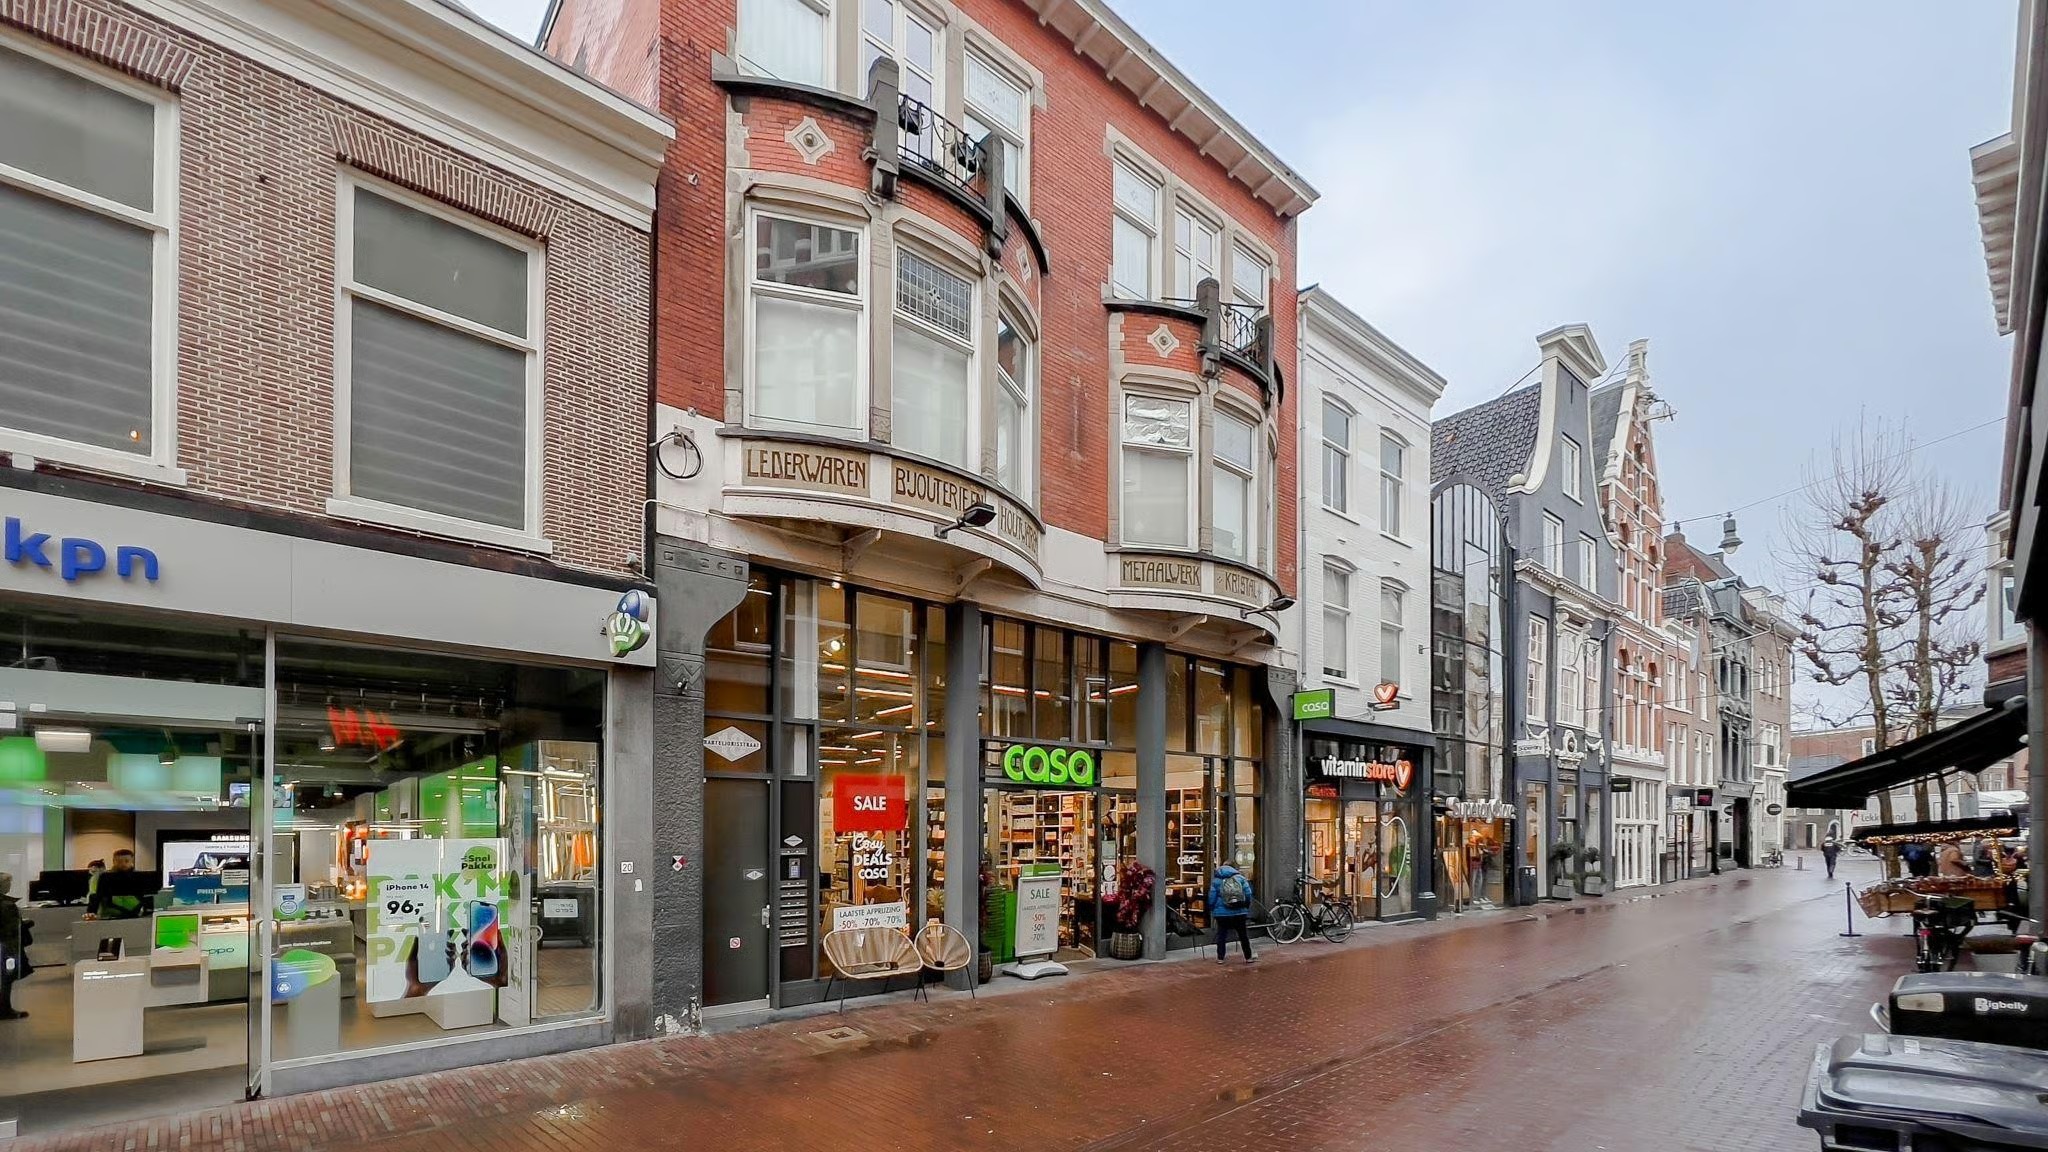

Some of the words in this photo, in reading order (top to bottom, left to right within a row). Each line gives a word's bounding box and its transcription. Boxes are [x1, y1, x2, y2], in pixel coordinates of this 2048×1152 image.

[747, 448, 866, 489] LEDERWAREN
[5, 516, 159, 581] kpn
[1122, 560, 1200, 587] METAALWERK
[1302, 701, 1329, 712] casa
[1004, 744, 1094, 785] casa
[1321, 755, 1395, 780] vitaminstore
[853, 796, 887, 811] SALE
[622, 863, 633, 872] 20
[854, 854, 893, 866] DEALS
[858, 868, 888, 879] casa
[1030, 888, 1050, 900] SALE
[840, 910, 865, 918] LAATSTE
[1974, 997, 2028, 1012] Bigbelly
